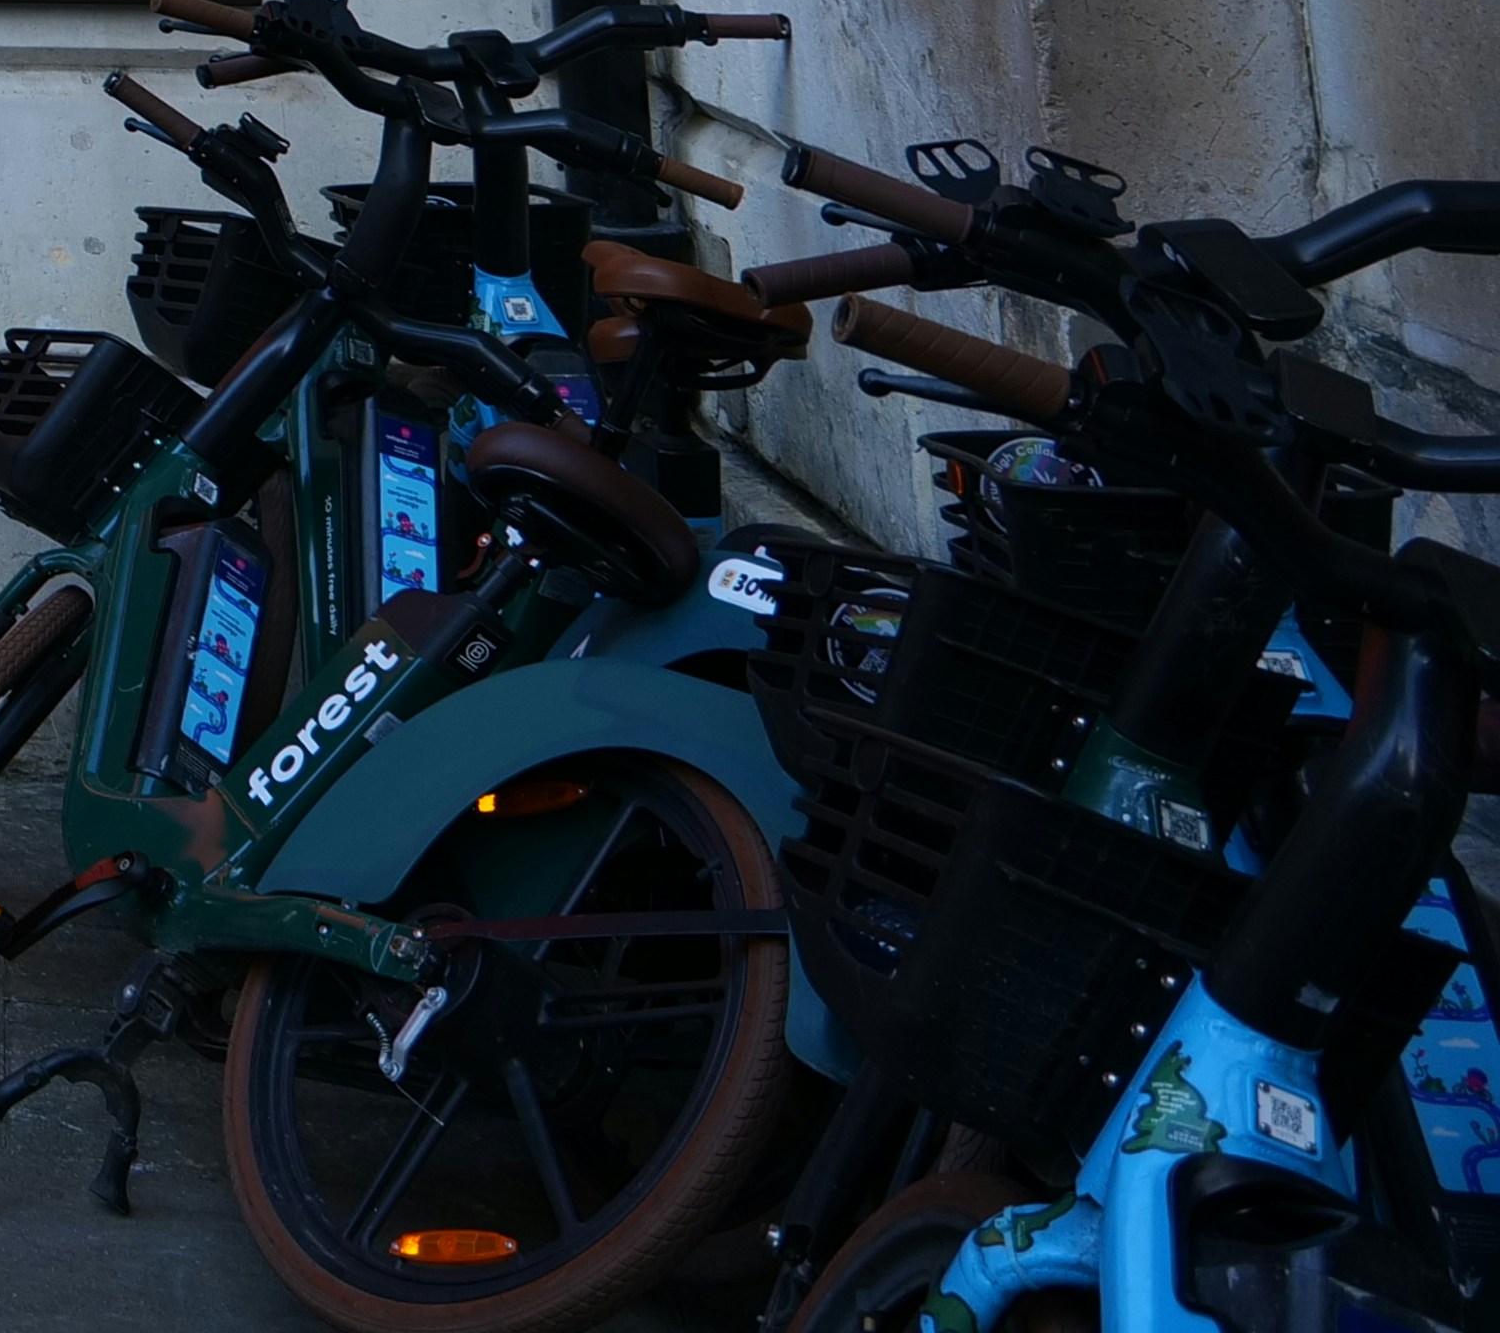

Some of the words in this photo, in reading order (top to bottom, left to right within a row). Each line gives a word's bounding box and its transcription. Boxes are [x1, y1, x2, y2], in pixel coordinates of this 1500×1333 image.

[325, 516, 334, 570] minutes
[327, 572, 336, 601] free
[329, 603, 338, 636] daily
[247, 640, 399, 807] forest
